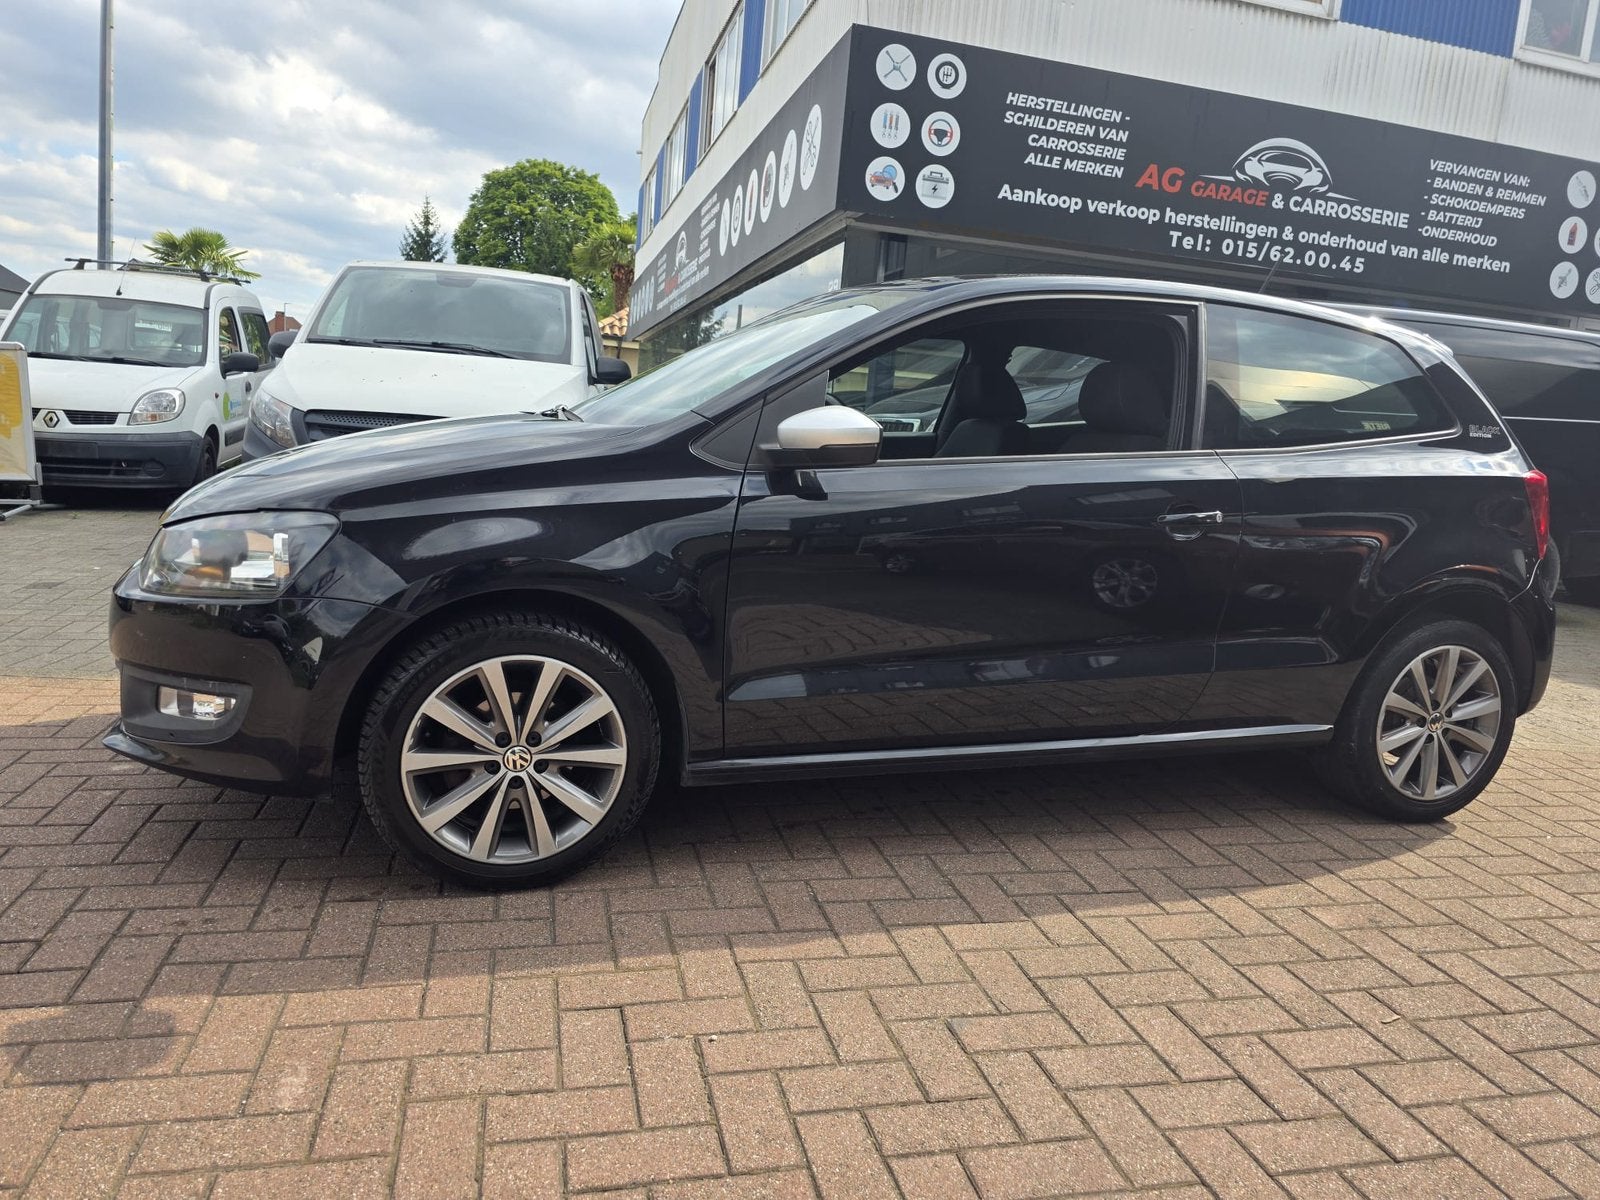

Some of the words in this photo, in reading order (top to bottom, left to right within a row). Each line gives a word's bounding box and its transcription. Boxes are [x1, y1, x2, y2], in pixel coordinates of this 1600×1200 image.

[1006, 92, 1122, 122] HERSTELLINGEN
[1004, 111, 1096, 137] SCHILDEREN
[1099, 126, 1129, 142] VAN
[1027, 134, 1127, 160] CARROSSERIE
[1024, 152, 1062, 169] ALLE
[1063, 158, 1124, 178] MERKEN
[1430, 159, 1501, 182] VERVANGEN
[1503, 172, 1530, 187] VAN:
[1135, 163, 1185, 193] AG
[1190, 181, 1269, 206] GARAGE
[1272, 193, 1284, 209] &
[1289, 196, 1410, 229] CARROSSERIE
[1430, 193, 1526, 219] SCHOKDEMPERS
[1433, 177, 1484, 195] BANDEN
[1485, 186, 1493, 197] &
[1496, 188, 1547, 206] REMMEN
[998, 184, 1082, 213] Aankoop
[1087, 198, 1160, 225] verkoop
[1164, 207, 1278, 239] herstellingen
[1282, 226, 1294, 241] &
[1298, 231, 1386, 255] onderhoud
[1391, 244, 1418, 259] van
[1422, 246, 1449, 263] alle
[1452, 256, 1511, 273] merken
[1427, 210, 1483, 228] BATTERIJ
[1169, 231, 1211, 252] Tel:
[1222, 238, 1365, 273] 015/62.00.45
